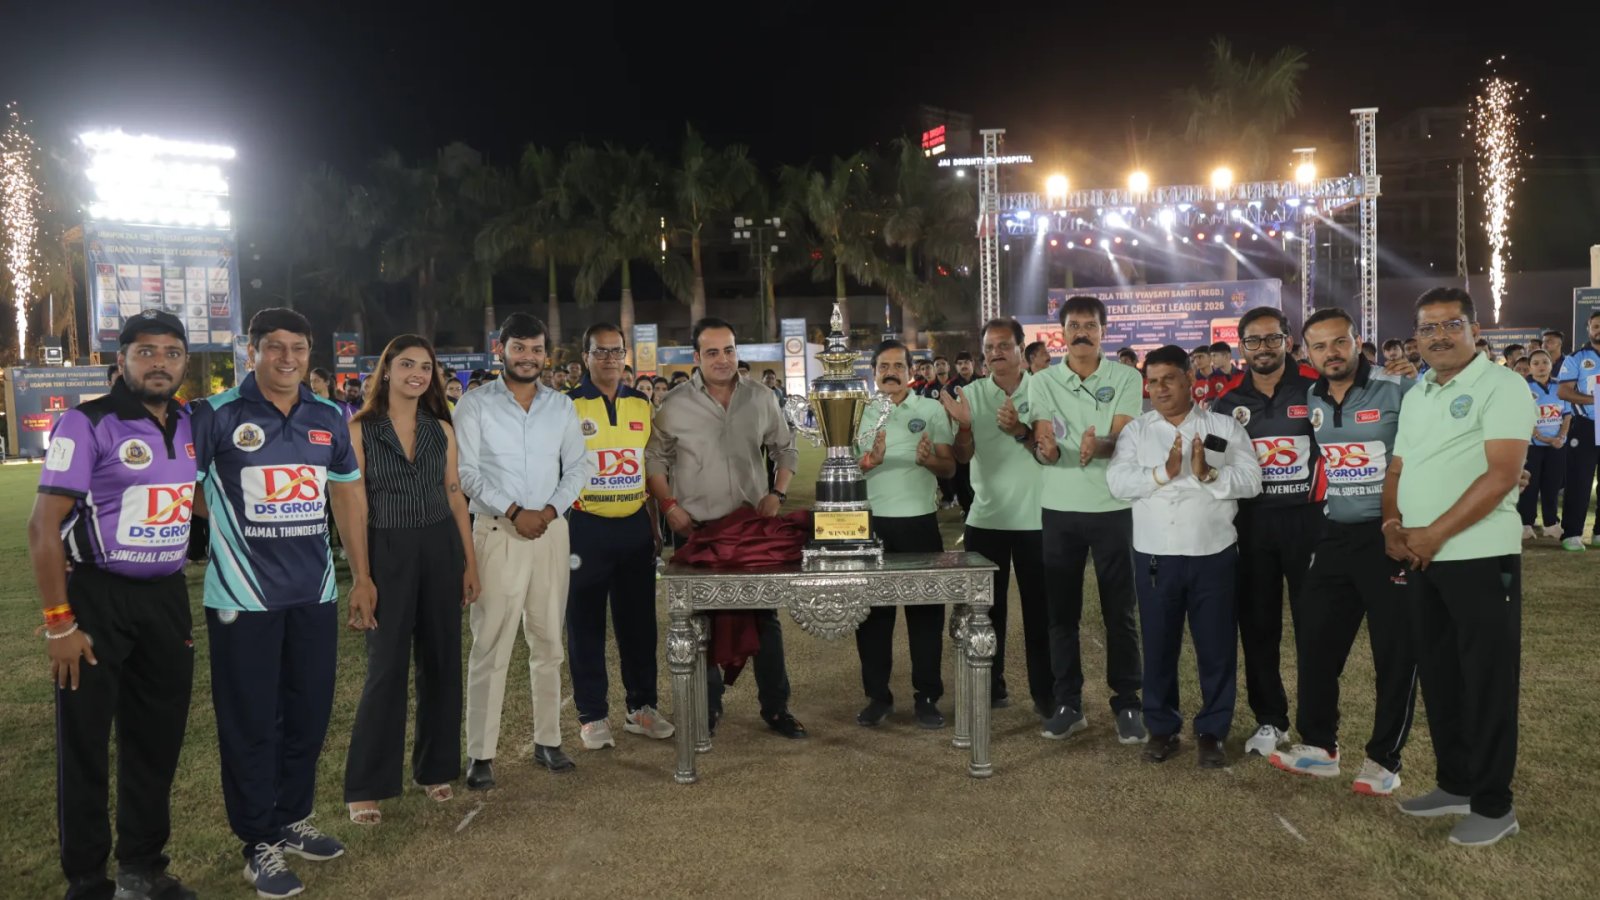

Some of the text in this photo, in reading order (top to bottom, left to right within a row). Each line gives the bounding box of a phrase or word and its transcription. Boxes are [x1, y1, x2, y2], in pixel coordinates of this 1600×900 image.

[938, 159, 950, 167] JAI
[1098, 292, 1114, 300] ZILA
[1115, 291, 1133, 300] TENT
[1171, 289, 1197, 298] SAMITI
[1107, 301, 1225, 314] TENT CRICKET LEAGUE 2026
[1252, 438, 1298, 468] DS
[1322, 443, 1370, 469] DS
[595, 449, 639, 477] DS
[1333, 467, 1378, 478] GROUP
[262, 466, 320, 503] DS
[609, 475, 641, 485] GROUP
[1266, 483, 1310, 494] AVENGERS
[1341, 485, 1366, 496] SUPER
[143, 484, 193, 525] DS
[254, 501, 323, 514] DS GROUP
[129, 526, 155, 538] DS
[245, 526, 278, 538] KAMAL
[110, 550, 158, 563] SINGHAL
